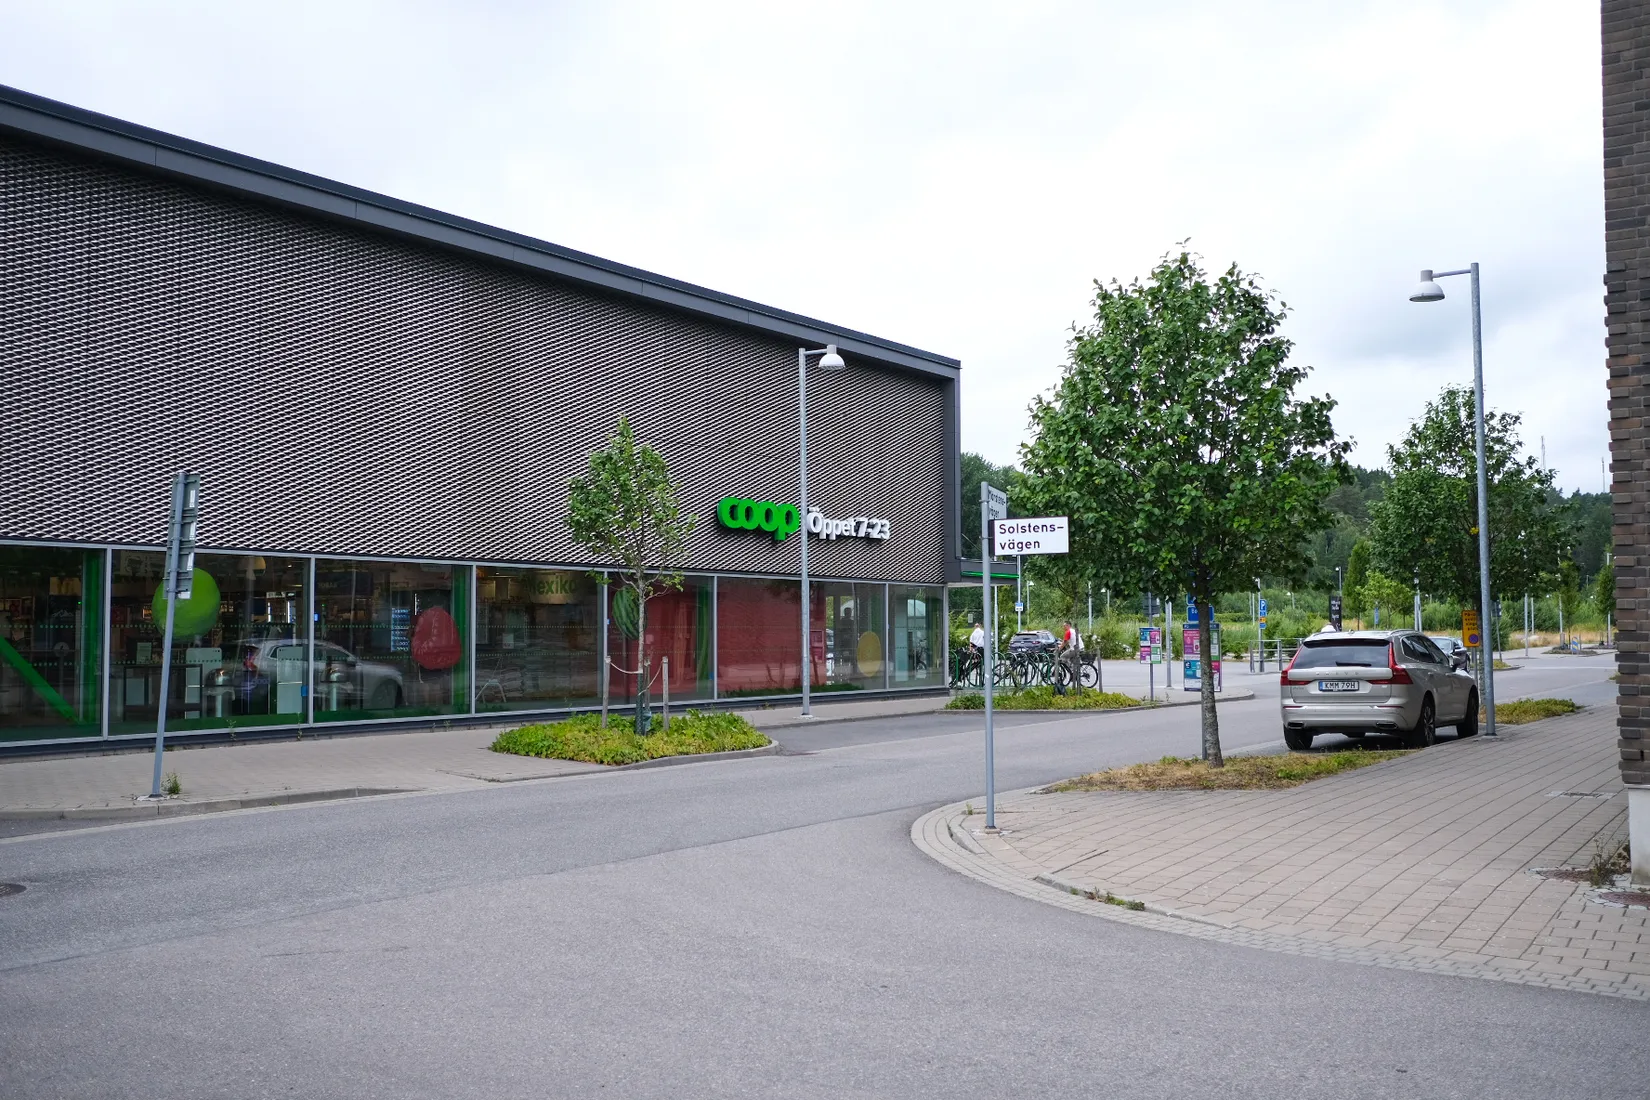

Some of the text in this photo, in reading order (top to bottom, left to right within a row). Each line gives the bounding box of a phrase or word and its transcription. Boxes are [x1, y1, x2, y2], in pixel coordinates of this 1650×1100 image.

[717, 496, 801, 541] coop
[806, 506, 890, 540] Öppet 7-23
[998, 522, 1065, 535] Solstens-
[999, 539, 1041, 552] vägen
[1324, 681, 1356, 689] KMM 79H
